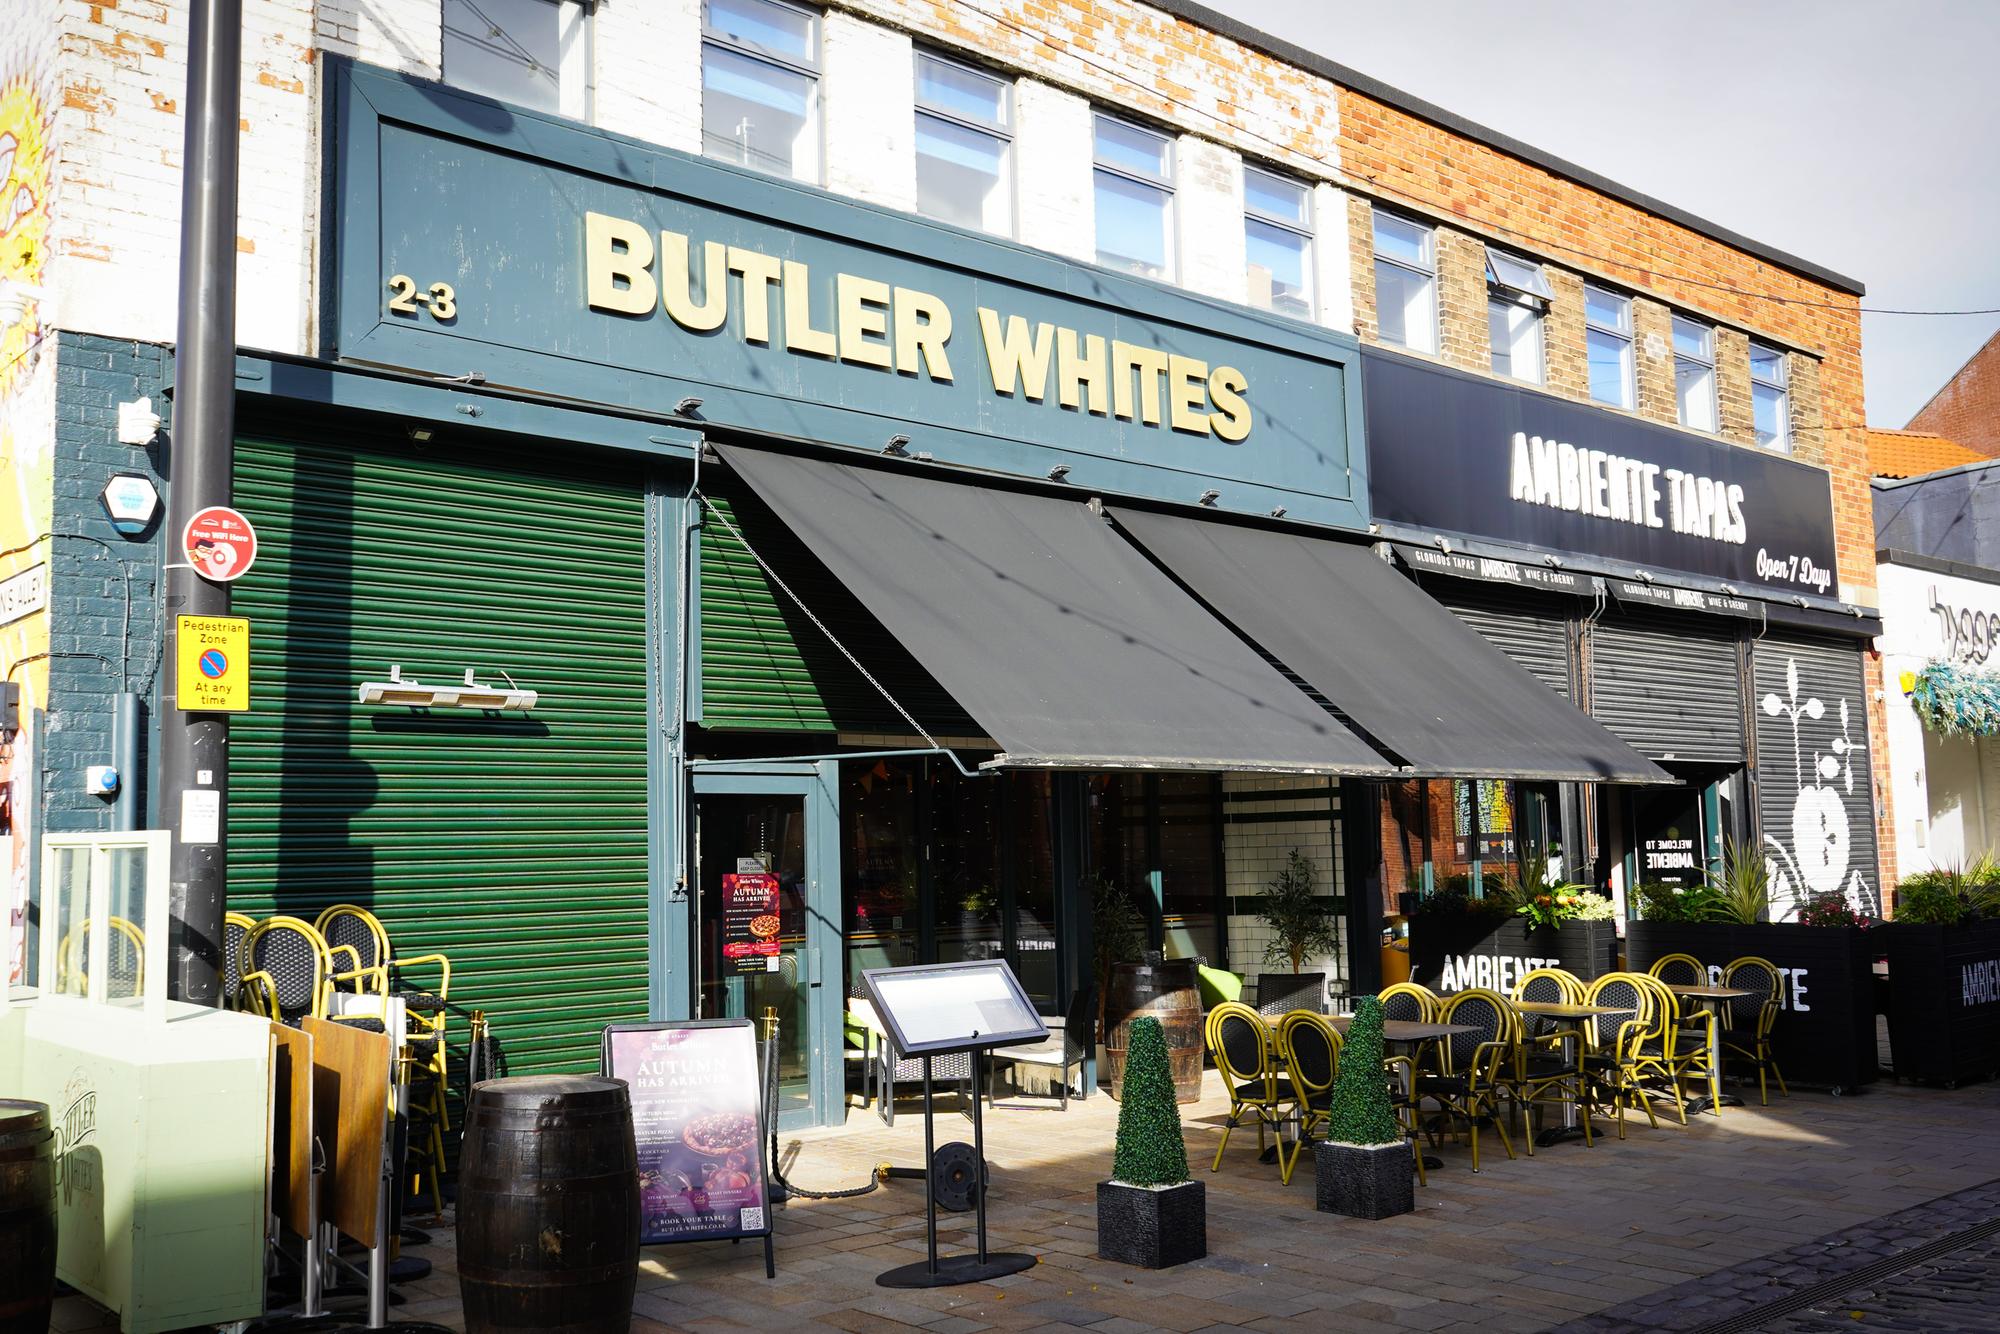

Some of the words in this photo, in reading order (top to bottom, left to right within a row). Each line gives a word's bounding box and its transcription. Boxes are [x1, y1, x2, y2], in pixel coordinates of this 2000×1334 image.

[388, 273, 457, 320] 2-3
[585, 211, 954, 383] BUTLER
[978, 306, 1252, 441] WHITES
[1511, 432, 1663, 529] AMBIENTE
[1665, 468, 1747, 545] TAPAS
[192, 529, 211, 538] Free
[229, 533, 249, 542] Here
[1415, 550, 1451, 566] GLORIOUS
[1452, 556, 1475, 571] TAPAS
[1480, 558, 1521, 582] AMBIENTE
[1524, 568, 1541, 580] WINE
[1542, 571, 1548, 582] &
[1550, 572, 1575, 586] SHERRY
[1757, 548, 1789, 581] Open
[1789, 555, 1799, 582] 7
[1799, 557, 1831, 592] Days
[1623, 583, 1652, 597] GLORIOUS
[1652, 587, 1671, 600] TAPAS
[1673, 588, 1706, 609] AMBIENTE
[1707, 596, 1722, 607] WINE
[1728, 600, 1748, 611] SHERRY
[183, 620, 244, 632] Pedestrian
[200, 633, 227, 644] Zone
[195, 682, 208, 692] At
[212, 685, 232, 694] any
[201, 695, 226, 705] time
[733, 887, 770, 896] AUTUMN
[637, 1059, 728, 1076] AUTUMN
[637, 1077, 664, 1088] HAS
[660, 1217, 680, 1225] BOOK
[704, 1214, 727, 1222] TABLE
